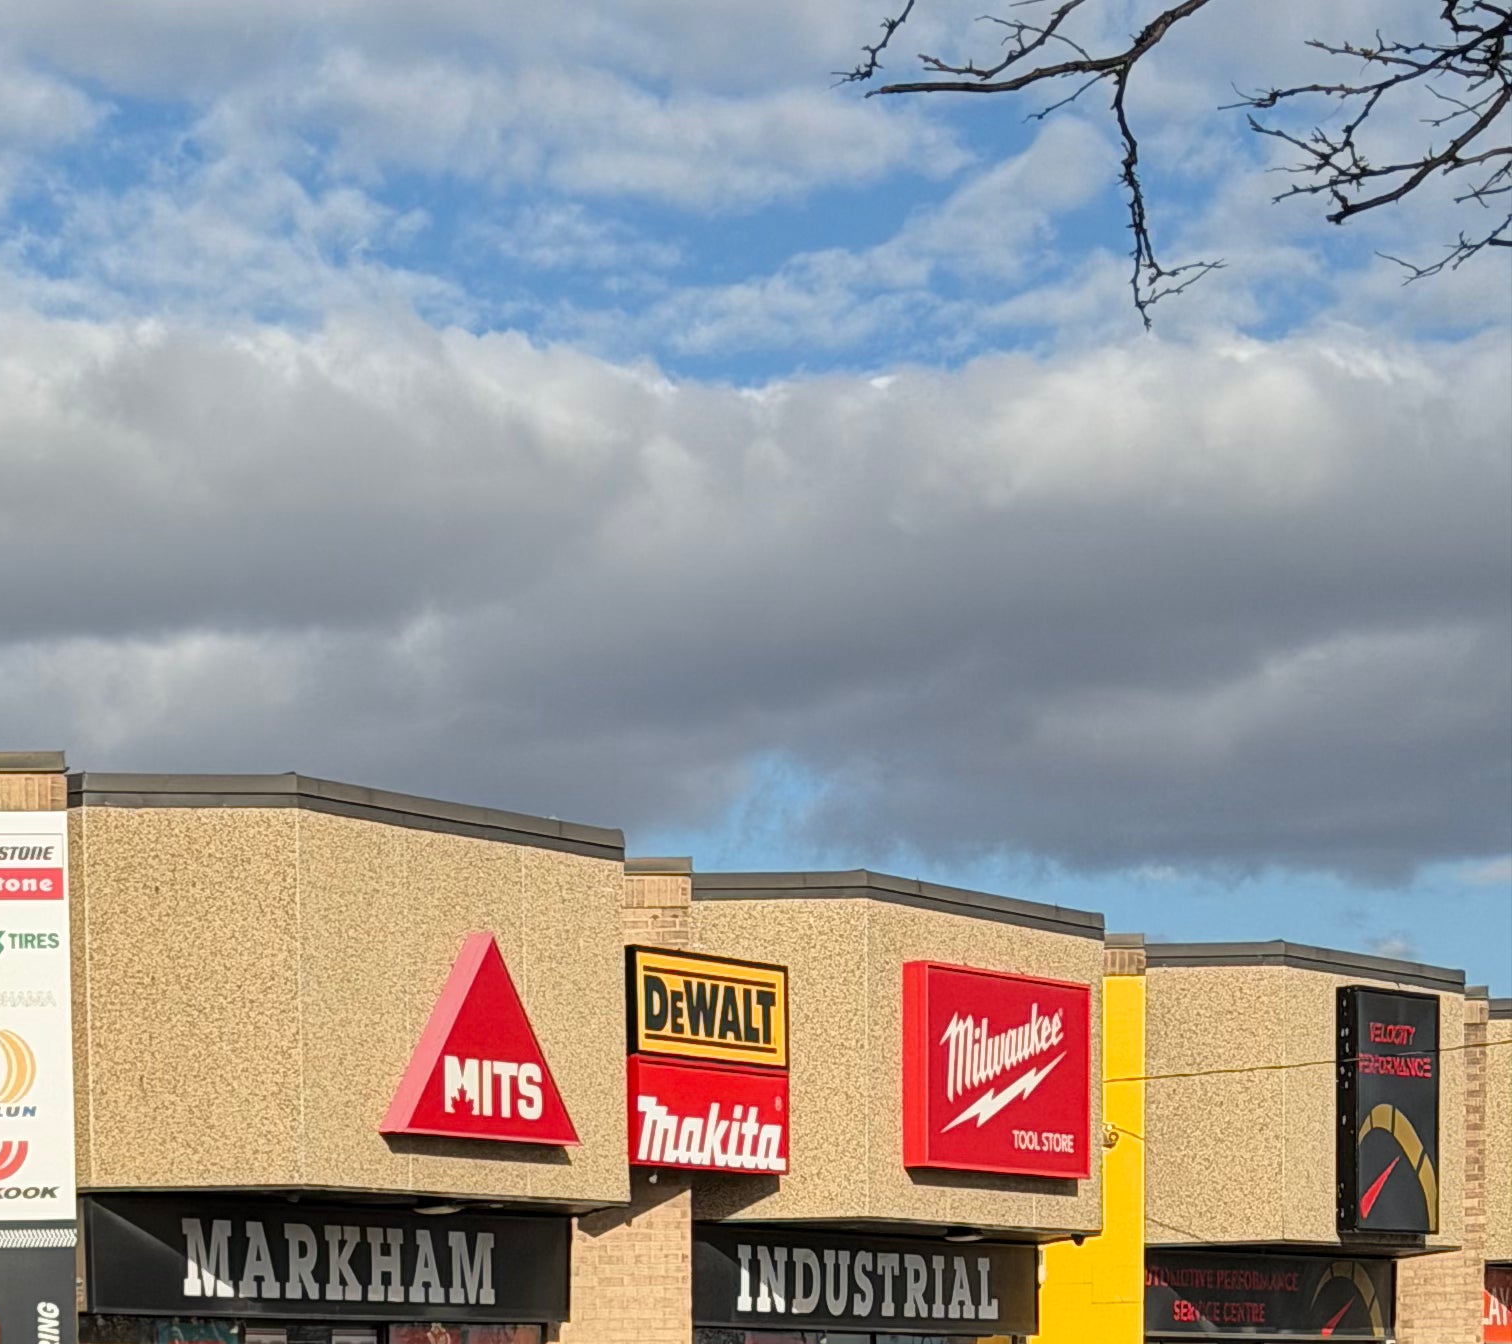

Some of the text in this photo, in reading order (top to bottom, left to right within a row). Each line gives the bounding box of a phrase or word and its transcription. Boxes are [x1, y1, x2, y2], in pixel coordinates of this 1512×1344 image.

[8, 933, 60, 950] TIRES
[939, 1003, 1065, 1104] Milwaukee
[444, 1055, 543, 1120] MITS
[1012, 1130, 1075, 1154] TOOL STORE
[182, 1217, 495, 1305] MARKHAM
[736, 1244, 999, 1320] INDUSTRIAL
[1216, 1270, 1299, 1291] PERFORMANCE
[1173, 1300, 1266, 1322] SERVICE CENTRE
